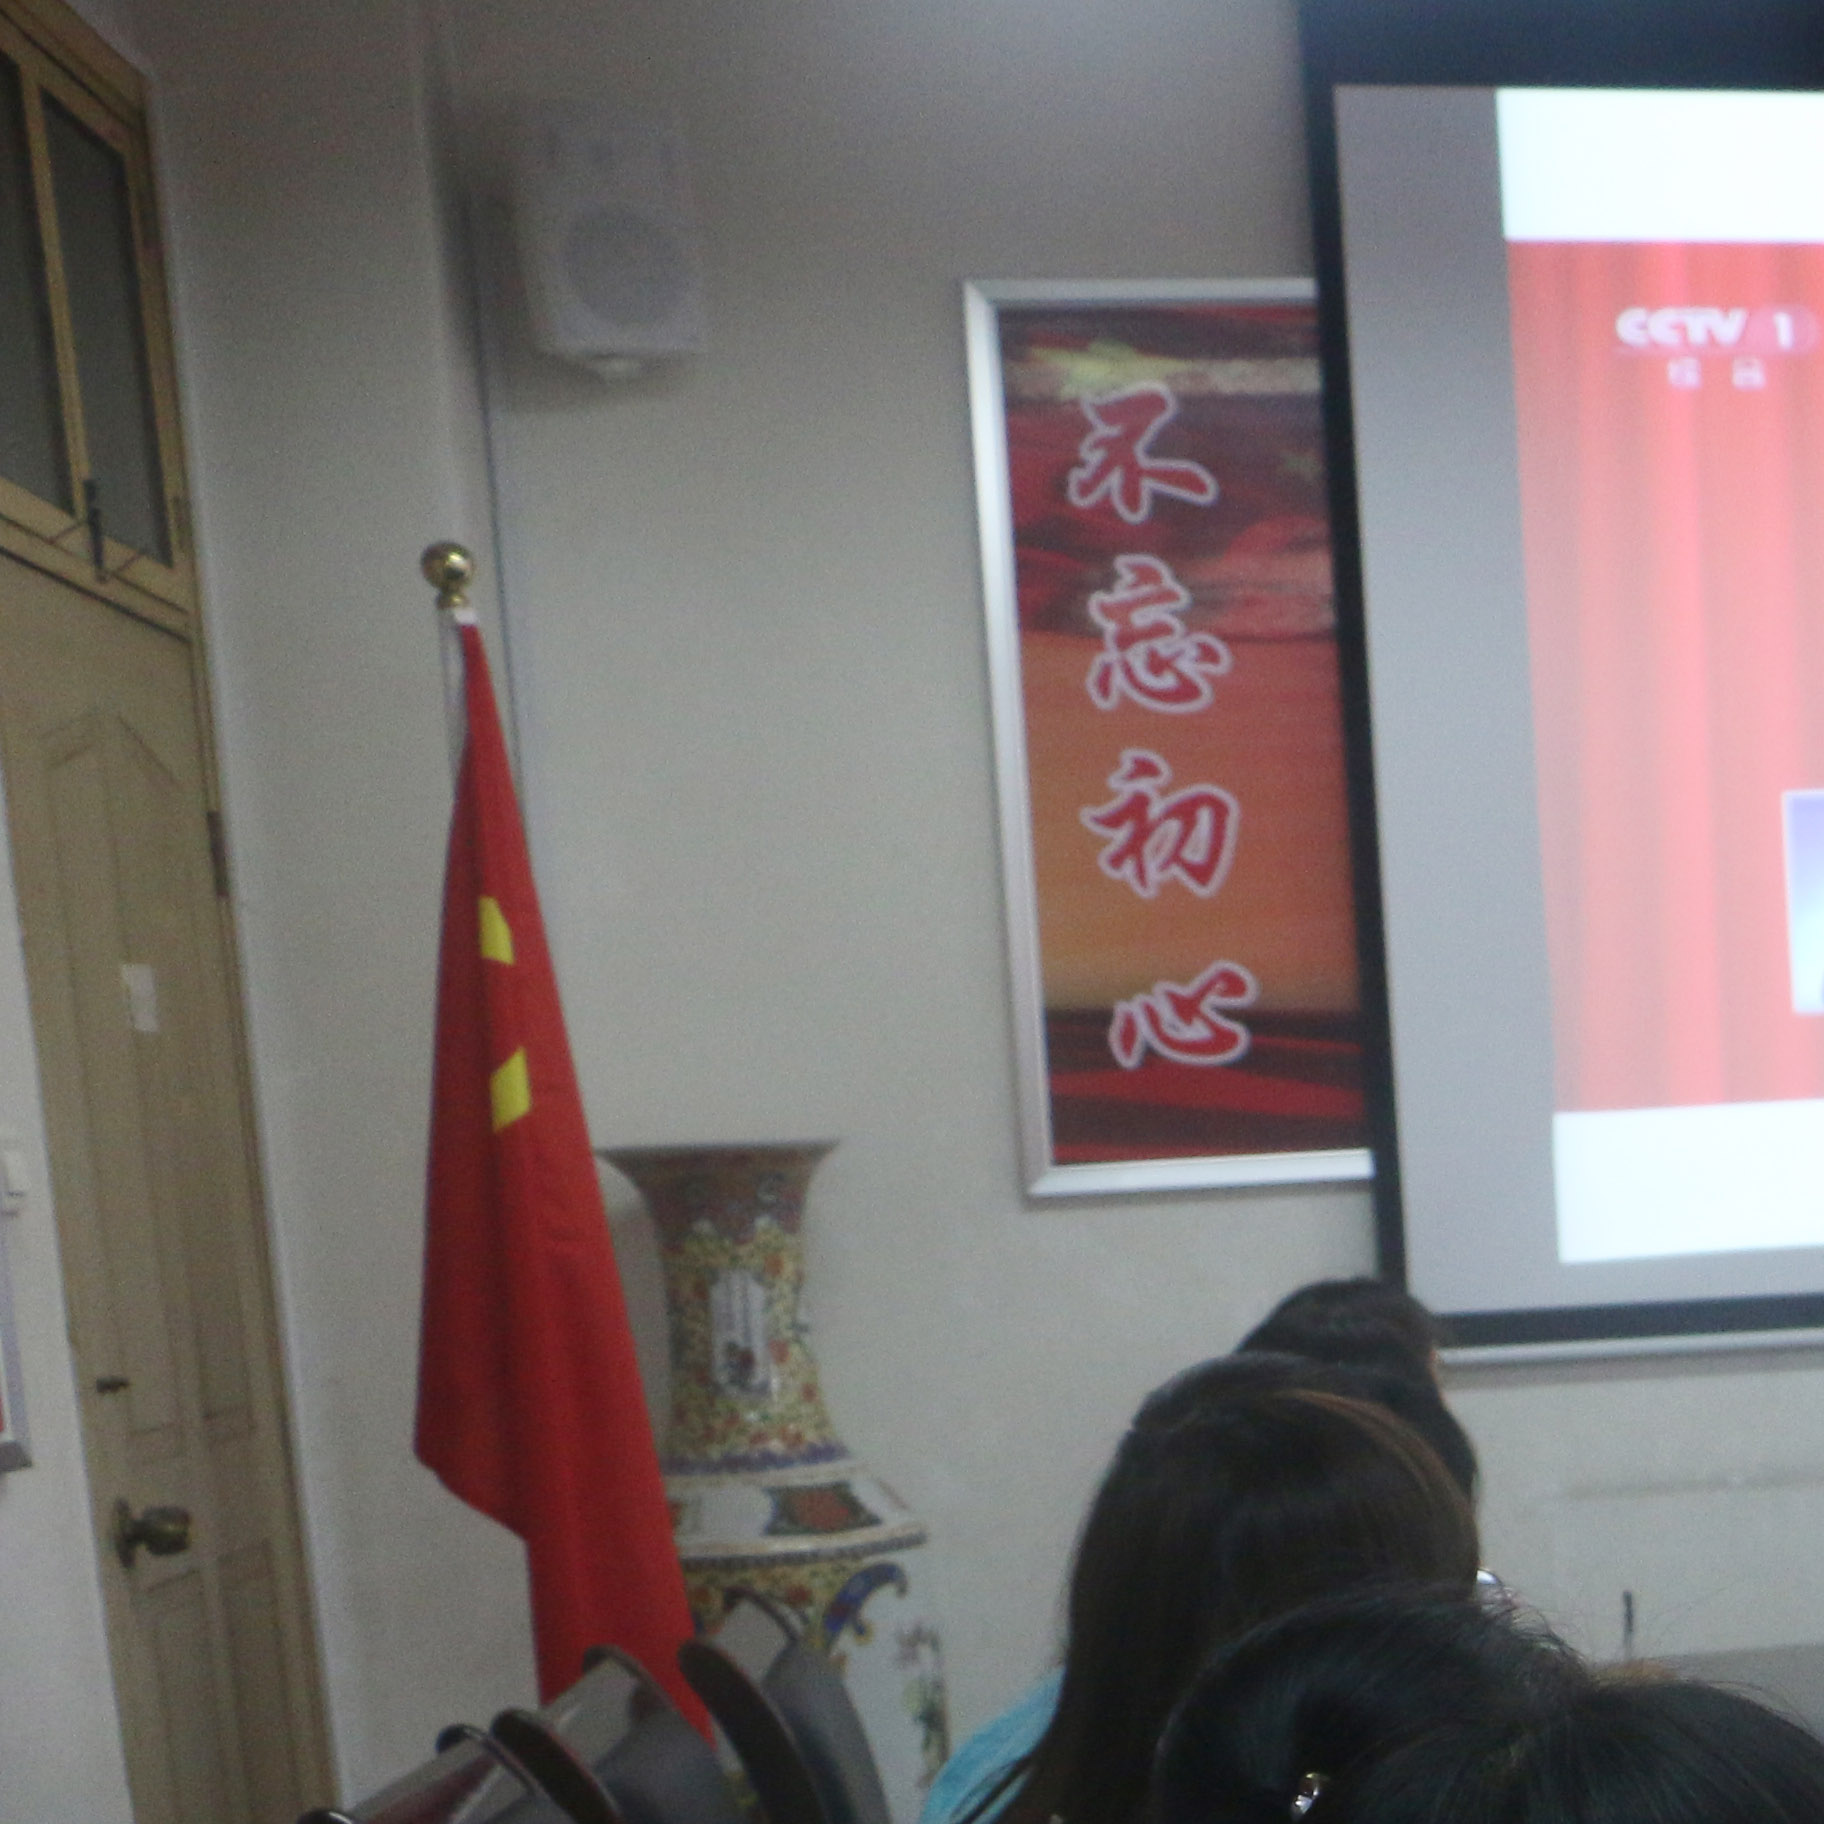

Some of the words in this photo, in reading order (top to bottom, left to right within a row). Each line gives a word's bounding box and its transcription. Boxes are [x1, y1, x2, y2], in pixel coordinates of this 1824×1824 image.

[1615, 306, 1748, 346] CCTV
[1067, 380, 1259, 1070] 不忘初心
